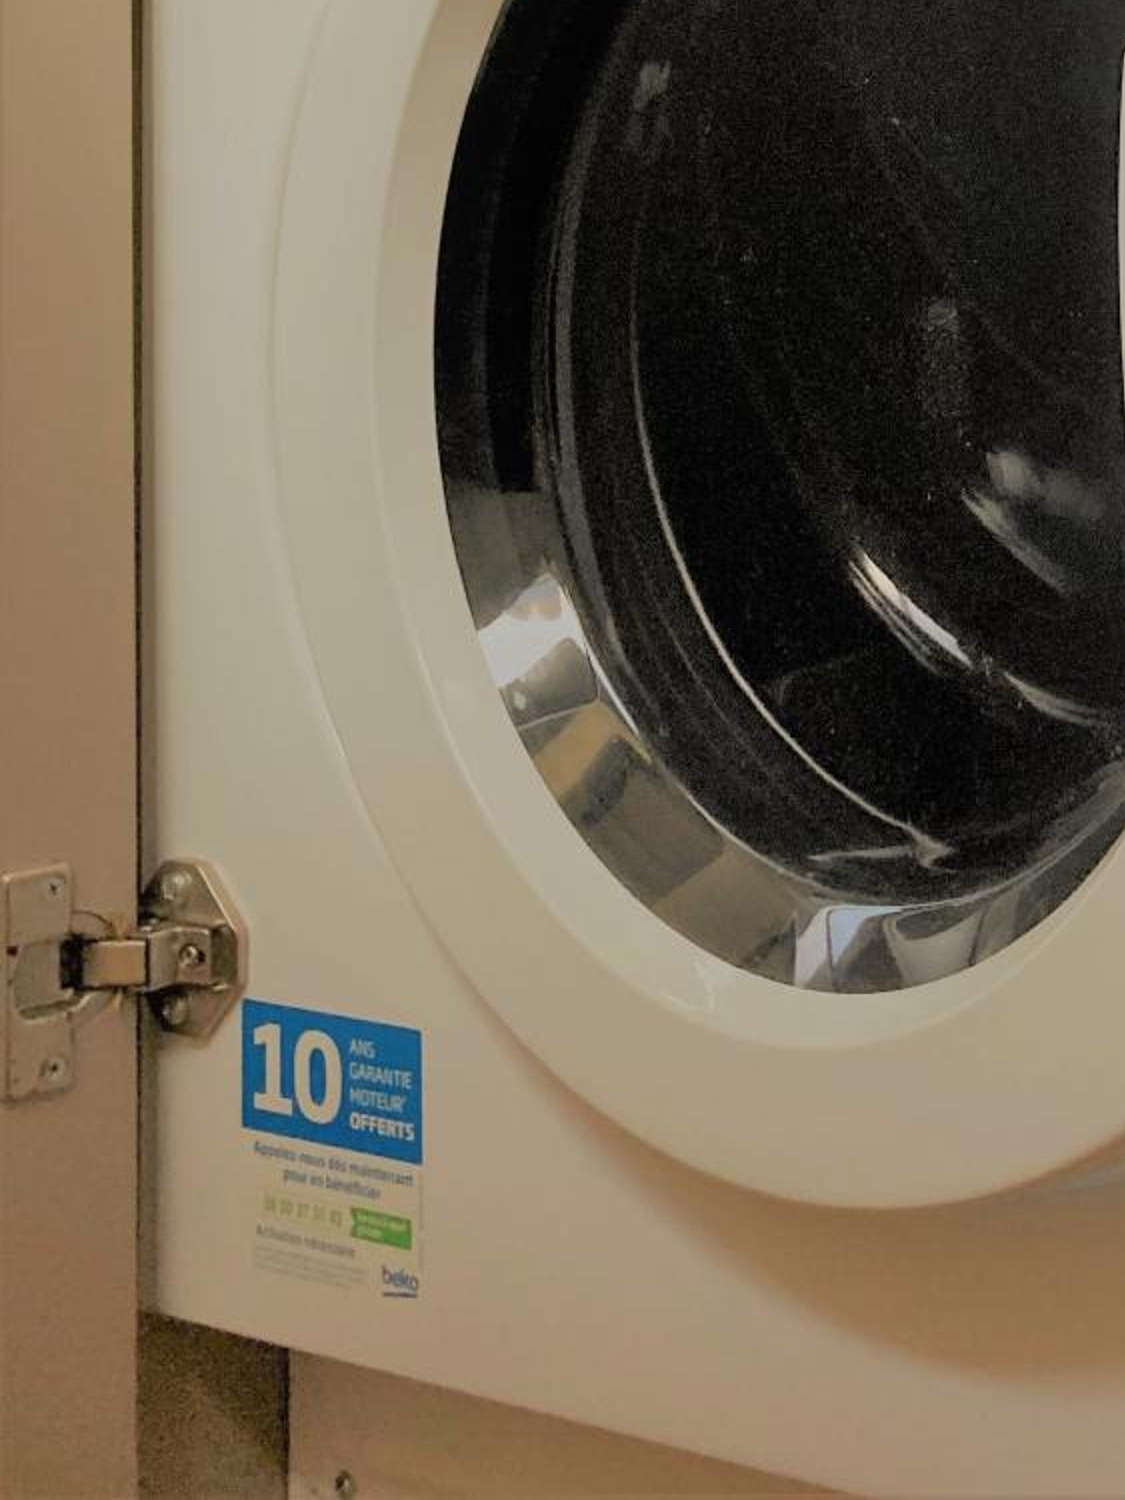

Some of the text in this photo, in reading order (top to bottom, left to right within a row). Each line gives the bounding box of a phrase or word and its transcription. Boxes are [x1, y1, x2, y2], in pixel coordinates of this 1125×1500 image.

[349, 1038, 377, 1060] ANS
[252, 1024, 343, 1125] 10
[349, 1062, 414, 1090] GARANTIE
[349, 1112, 416, 1142] OFFERTS
[382, 1263, 420, 1290] beko
